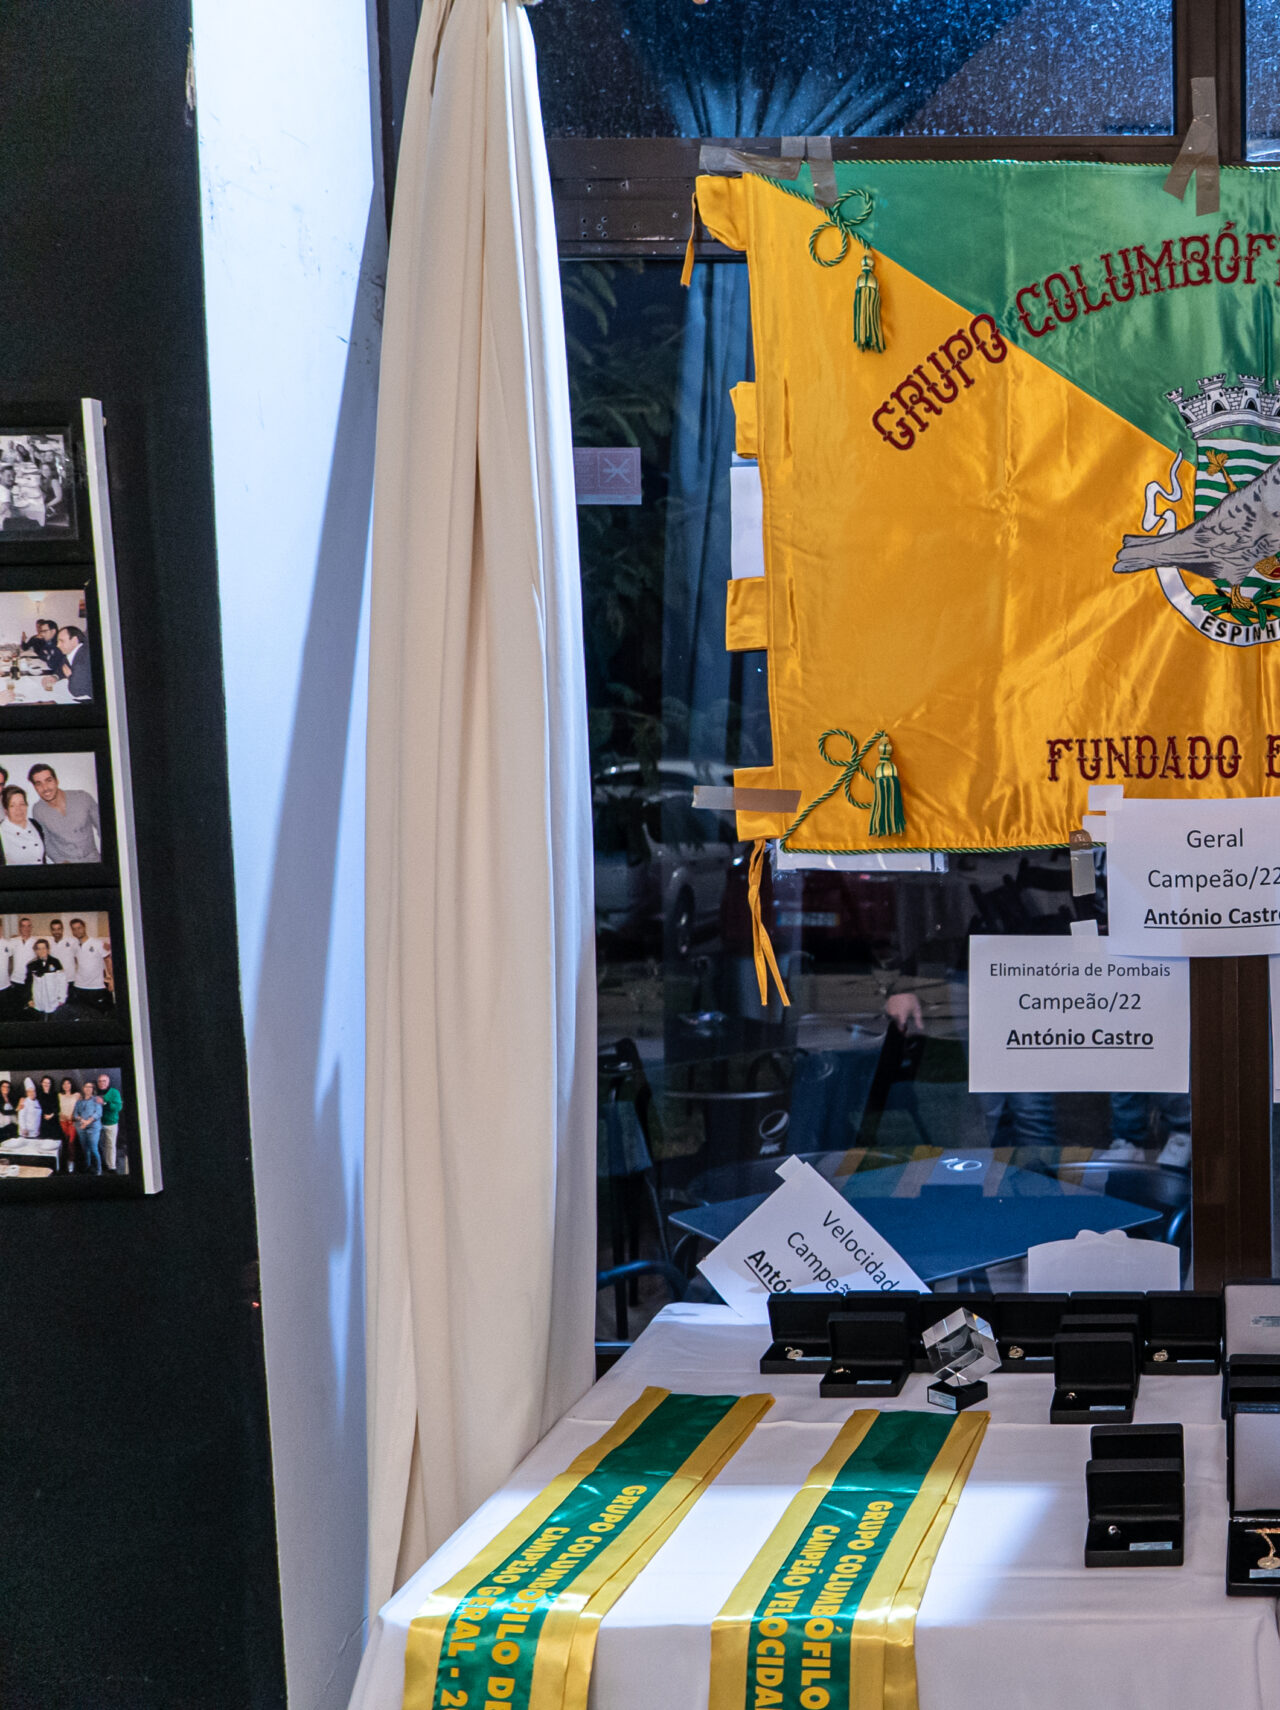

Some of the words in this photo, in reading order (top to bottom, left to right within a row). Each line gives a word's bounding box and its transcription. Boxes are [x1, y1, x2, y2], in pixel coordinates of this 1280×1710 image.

[873, 312, 1009, 451] GRUPO
[1047, 735, 1242, 782] FUNDADO
[1186, 827, 1244, 848] Geral
[1144, 907, 1223, 925] António
[990, 962, 1080, 977] Eliminatória
[1084, 962, 1103, 977] de
[1107, 962, 1171, 977] Pombais
[1018, 992, 1142, 1014] Campeão/22
[1006, 1027, 1085, 1047] António
[1091, 1028, 1154, 1046] Castro
[748, 1250, 792, 1293] Antó
[822, 1210, 900, 1291] Velocidad
[589, 1485, 647, 1532] GRUPO
[848, 1500, 894, 1550] GRUPO
[448, 1586, 506, 1657] GERAL
[492, 1536, 603, 1665] COLUMBÓFILO
[800, 1554, 867, 1710] COLUMBÓFILO
